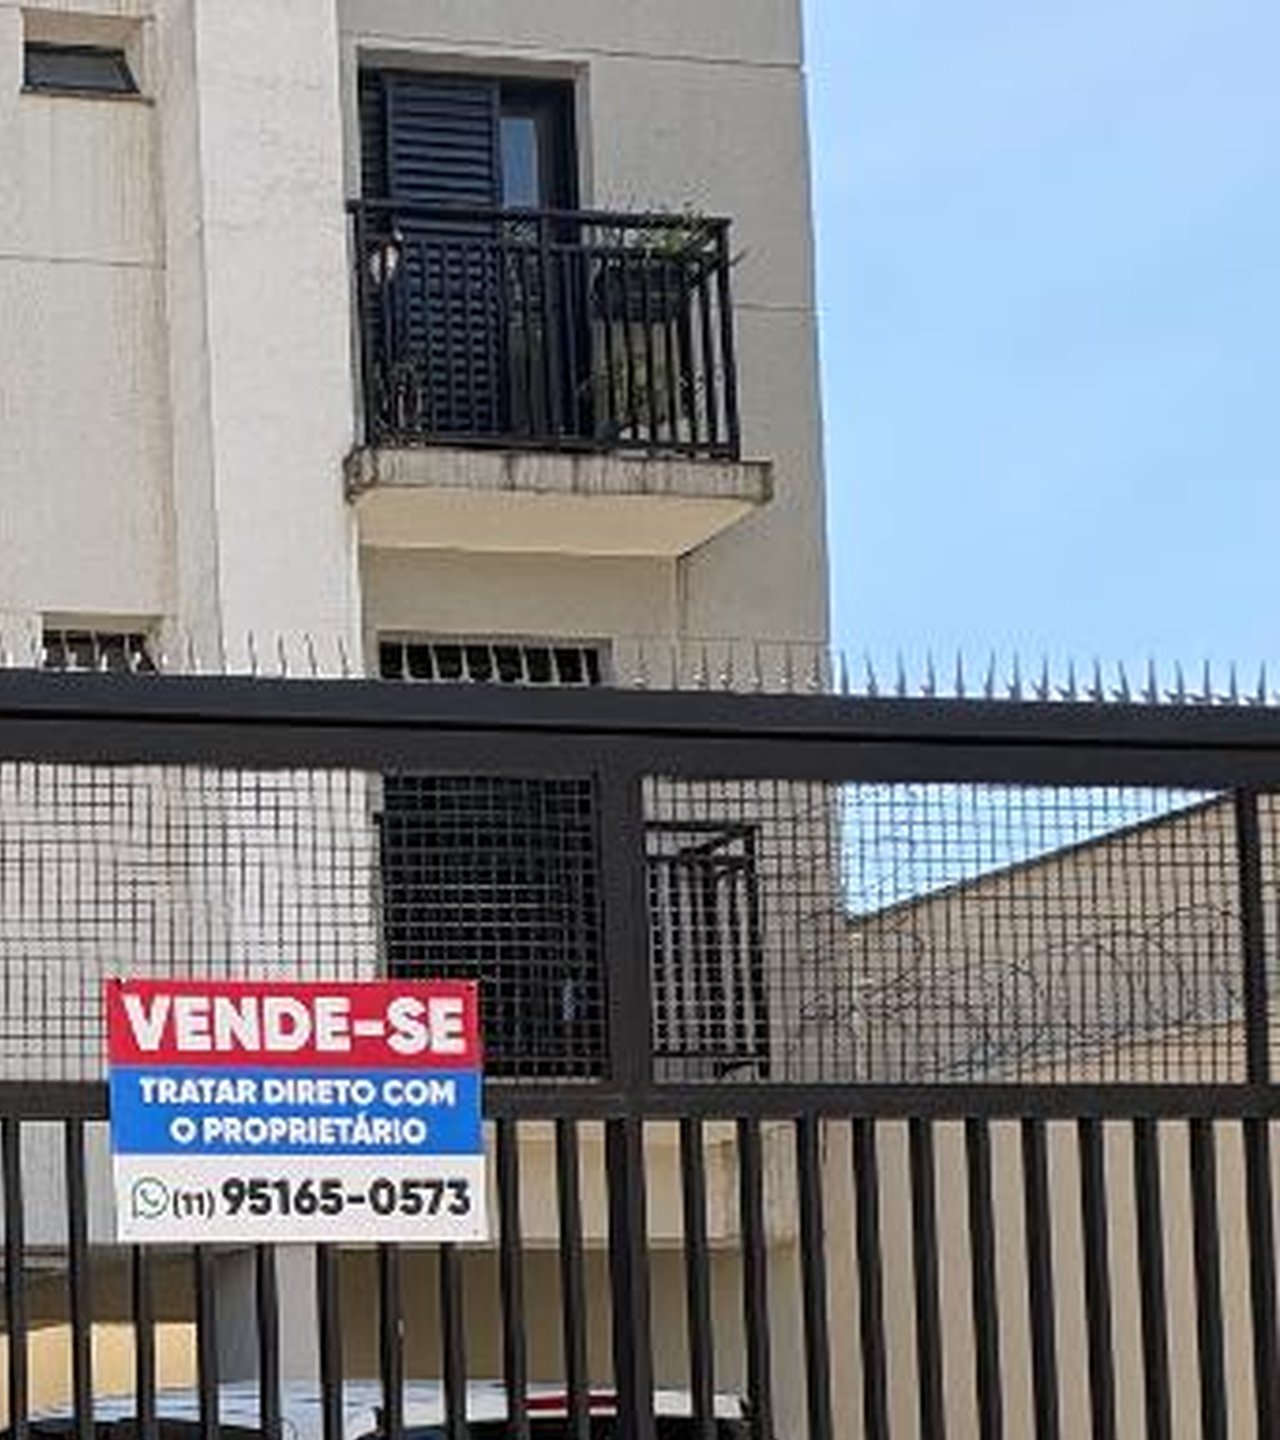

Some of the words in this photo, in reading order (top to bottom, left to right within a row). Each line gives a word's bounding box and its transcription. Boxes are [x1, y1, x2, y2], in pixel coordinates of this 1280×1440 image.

[122, 995, 467, 1055] VENDE-SE
[140, 1077, 259, 1105] TRATAR
[263, 1078, 376, 1106] DIRETO
[382, 1080, 457, 1107] COM
[169, 1117, 198, 1145] O
[203, 1110, 428, 1146] PROPRIETÁRIO
[171, 1189, 216, 1219] (11)
[221, 1177, 472, 1217] 95165-0573
